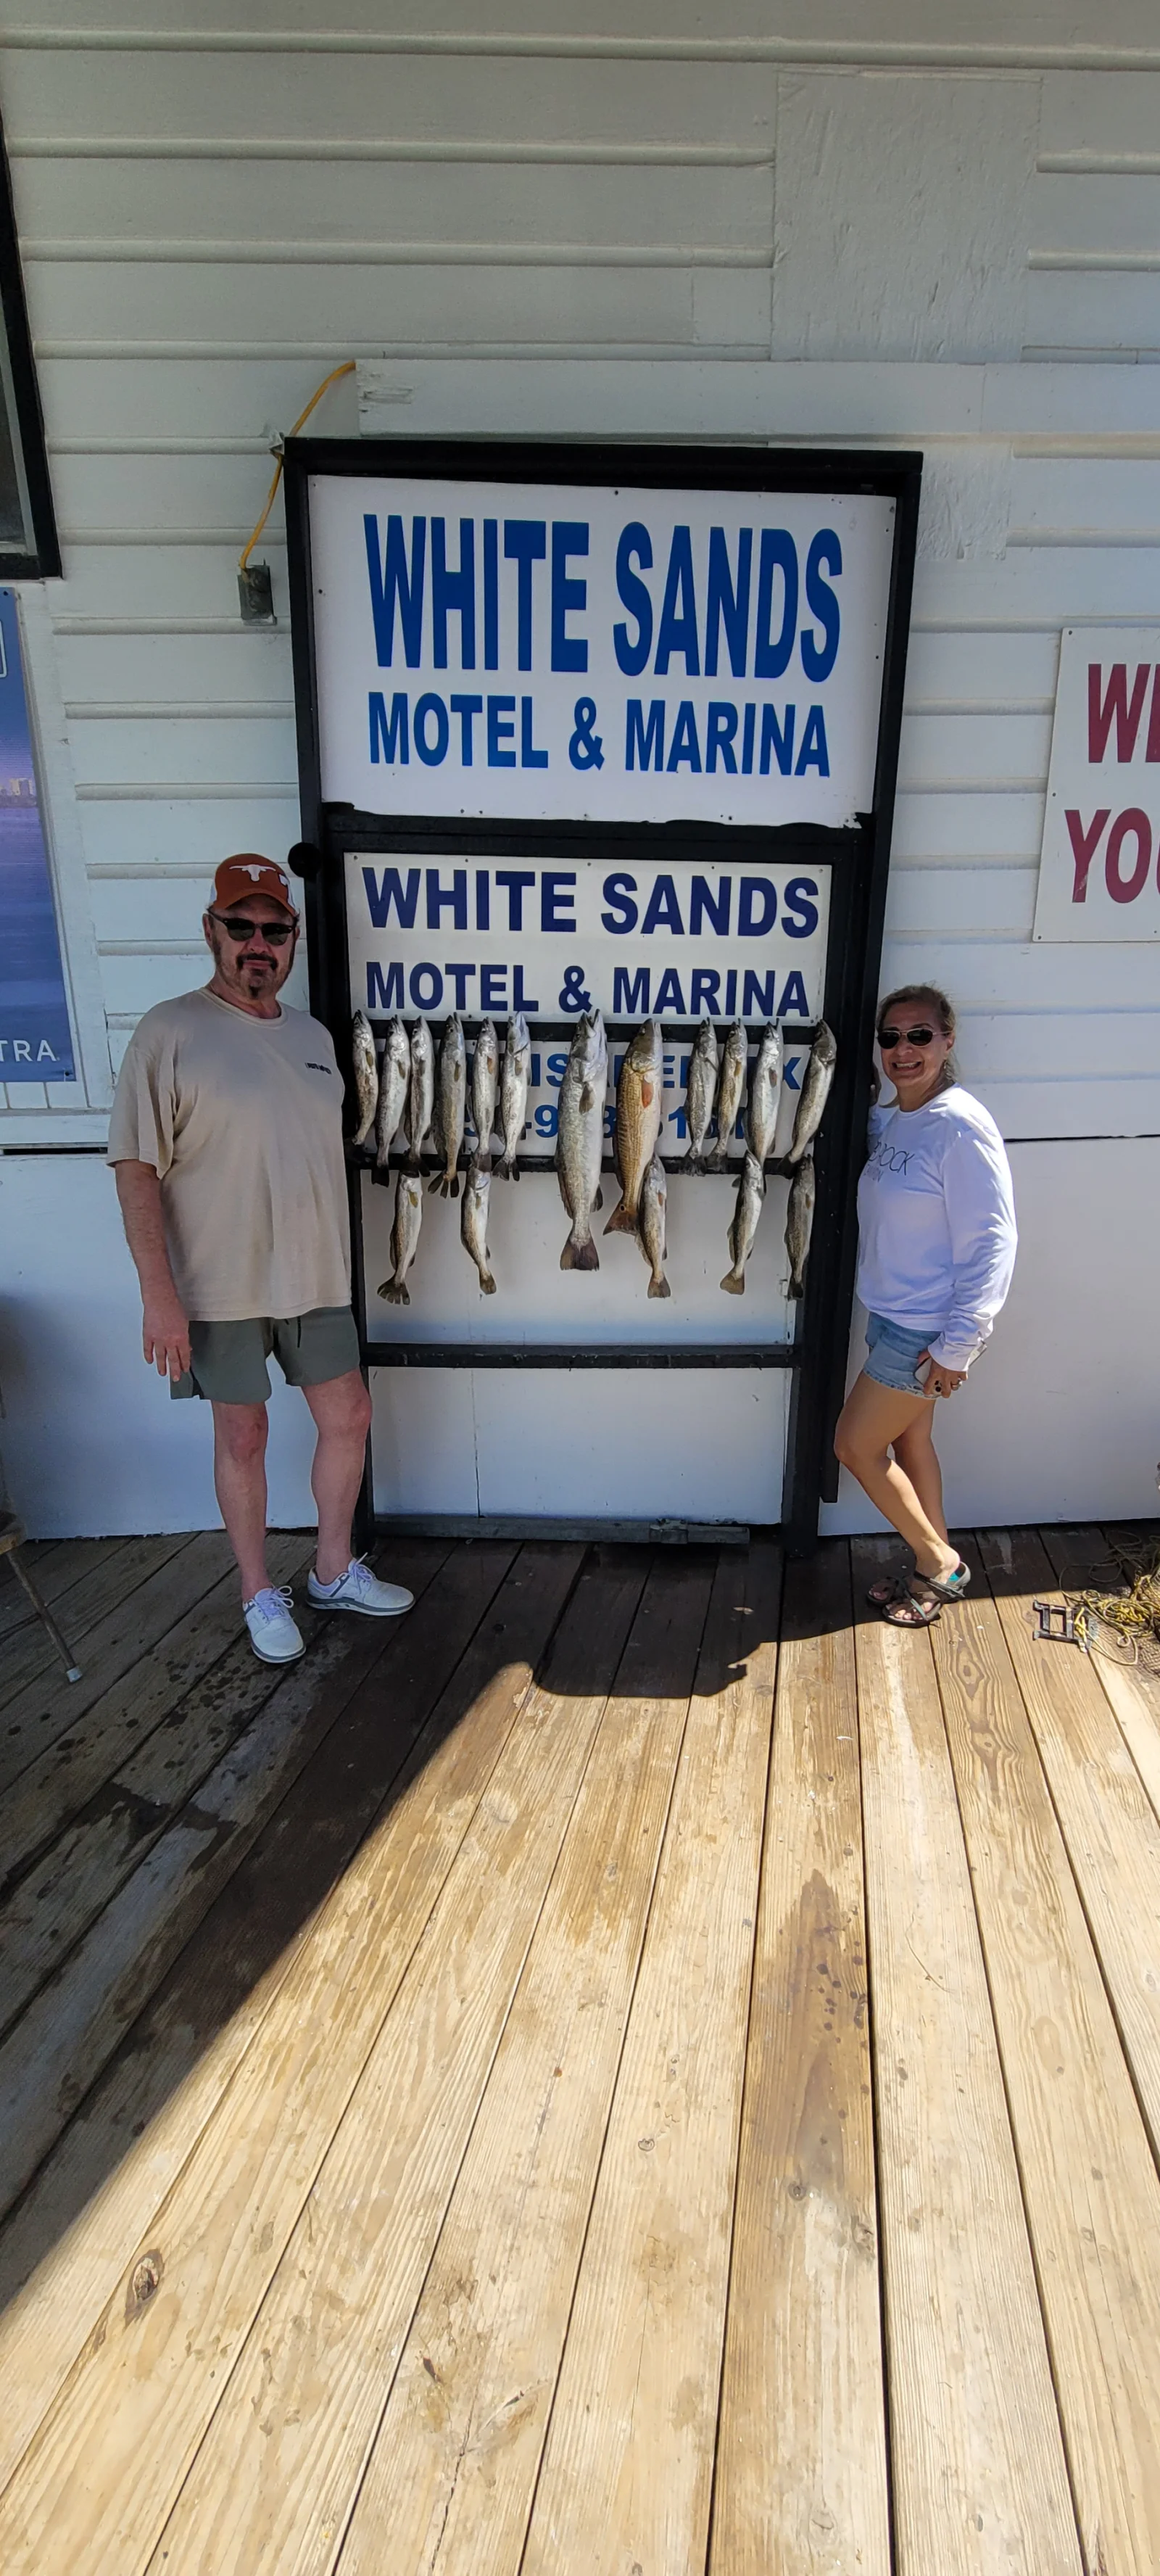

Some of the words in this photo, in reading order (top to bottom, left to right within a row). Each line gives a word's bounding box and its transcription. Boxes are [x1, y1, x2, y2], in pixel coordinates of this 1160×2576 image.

[363, 513, 589, 673] WHITE
[613, 521, 843, 682] SANDS
[368, 691, 549, 769] MOTEL
[568, 696, 605, 771] &
[625, 698, 831, 777] MARINA
[1064, 807, 1160, 904] YO
[362, 867, 576, 933] WHITE
[600, 872, 820, 938] SANDS
[366, 961, 539, 1012] MOTEL
[558, 965, 593, 1013] &
[613, 967, 810, 1017] MARINA
